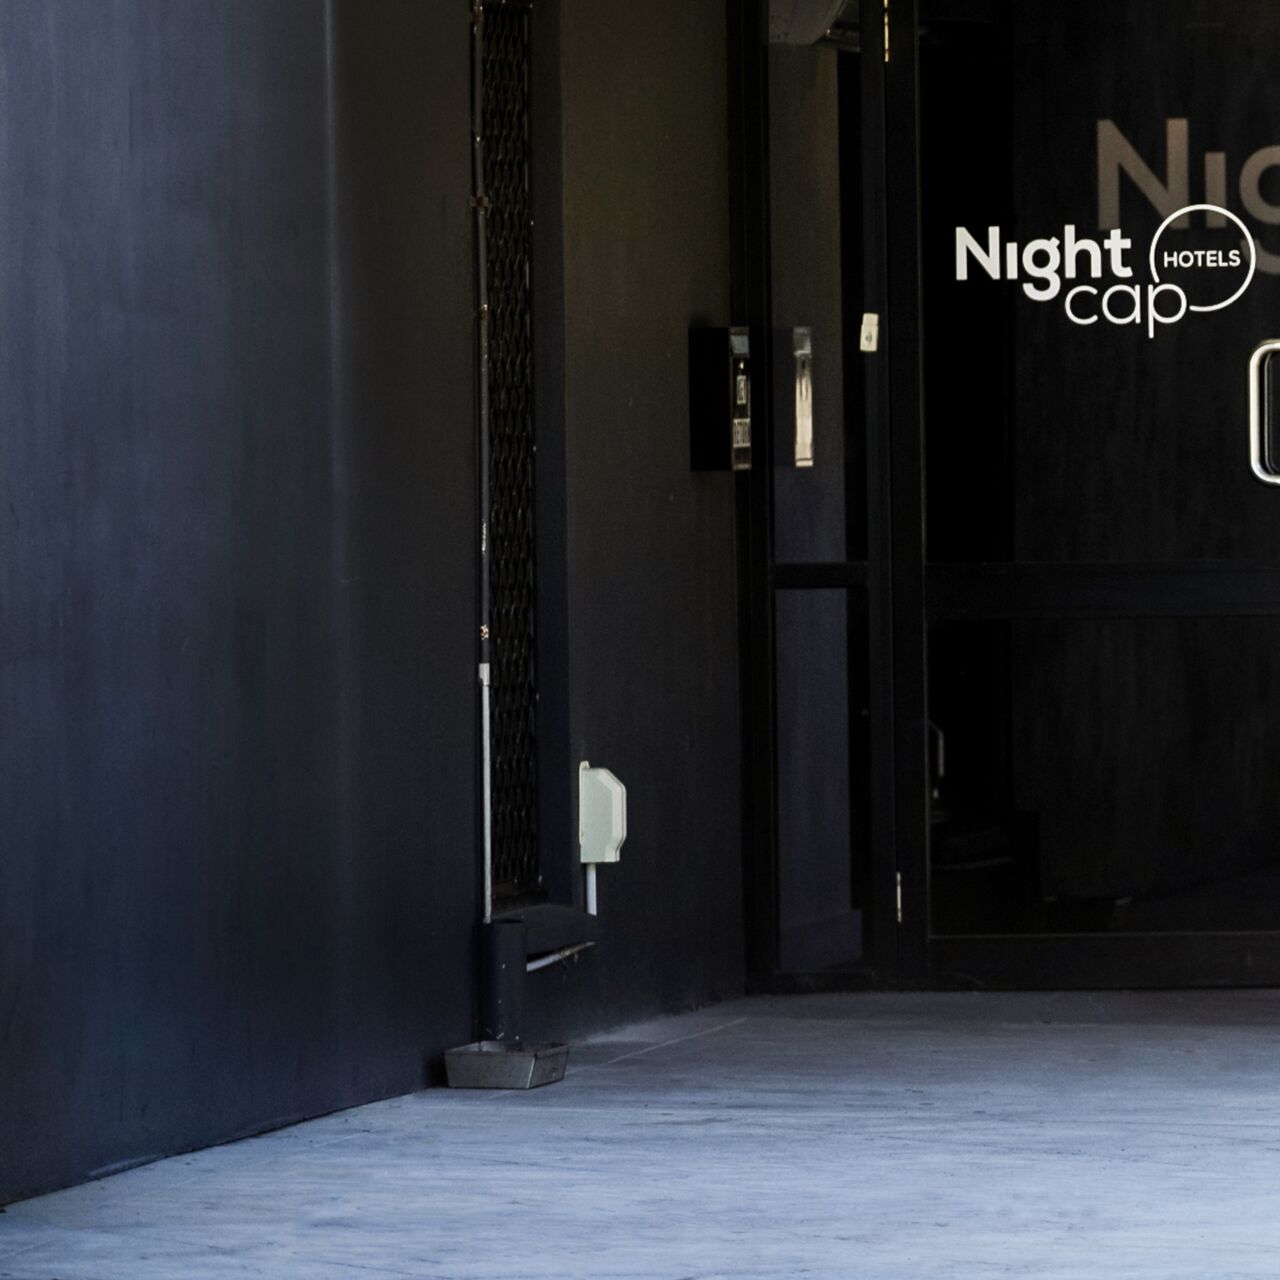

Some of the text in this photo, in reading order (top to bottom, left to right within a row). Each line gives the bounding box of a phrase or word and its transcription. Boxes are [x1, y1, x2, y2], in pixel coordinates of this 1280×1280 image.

[956, 223, 1133, 301] Night
[1162, 249, 1242, 269] HOTELS
[1063, 283, 1188, 339] cap
